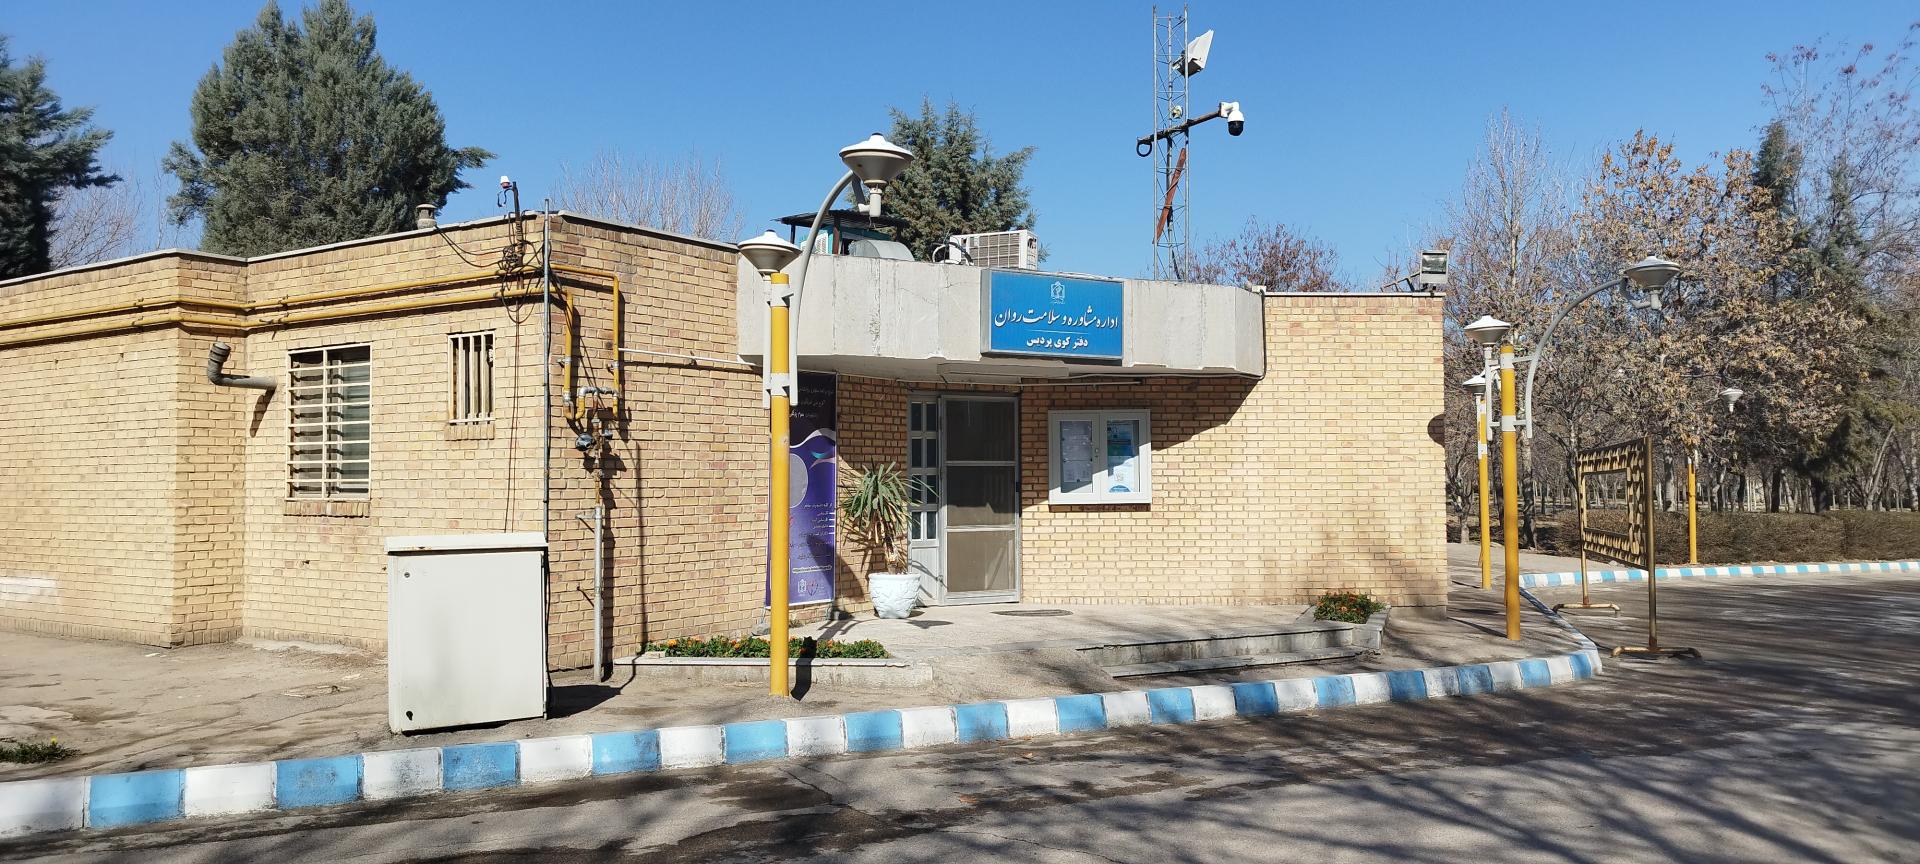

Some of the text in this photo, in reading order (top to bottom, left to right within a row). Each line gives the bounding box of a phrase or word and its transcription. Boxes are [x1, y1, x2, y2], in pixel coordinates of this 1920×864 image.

[994, 305, 1118, 328] اداره مشاوره و سلامت روان
[1026, 336, 1089, 349] دفتر کوی پردیس
